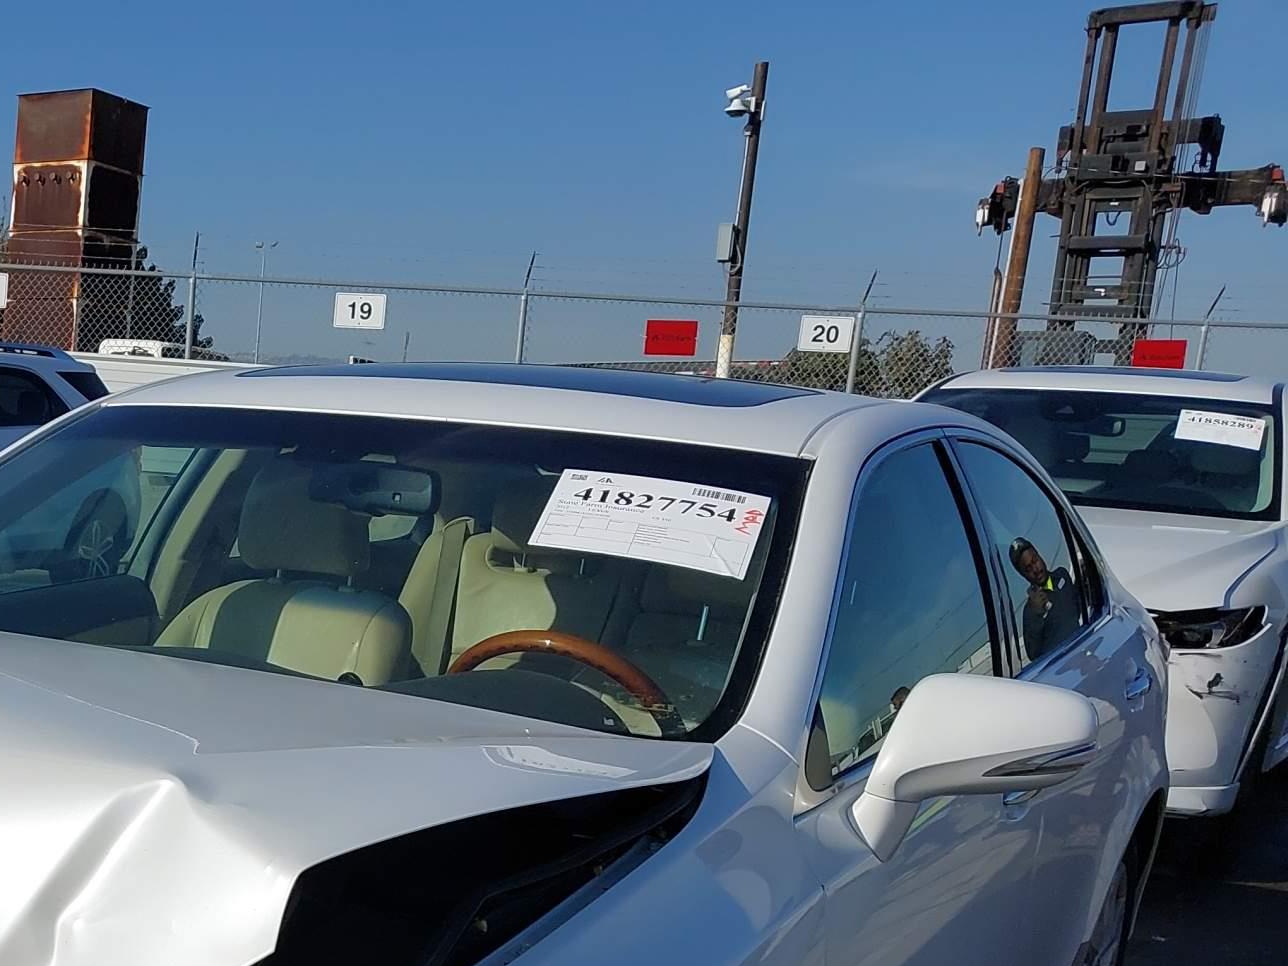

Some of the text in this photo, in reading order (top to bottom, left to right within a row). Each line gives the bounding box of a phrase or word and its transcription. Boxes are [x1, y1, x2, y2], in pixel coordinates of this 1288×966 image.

[348, 301, 372, 320] 19
[811, 324, 840, 344] 20
[573, 487, 736, 522] 41827754
